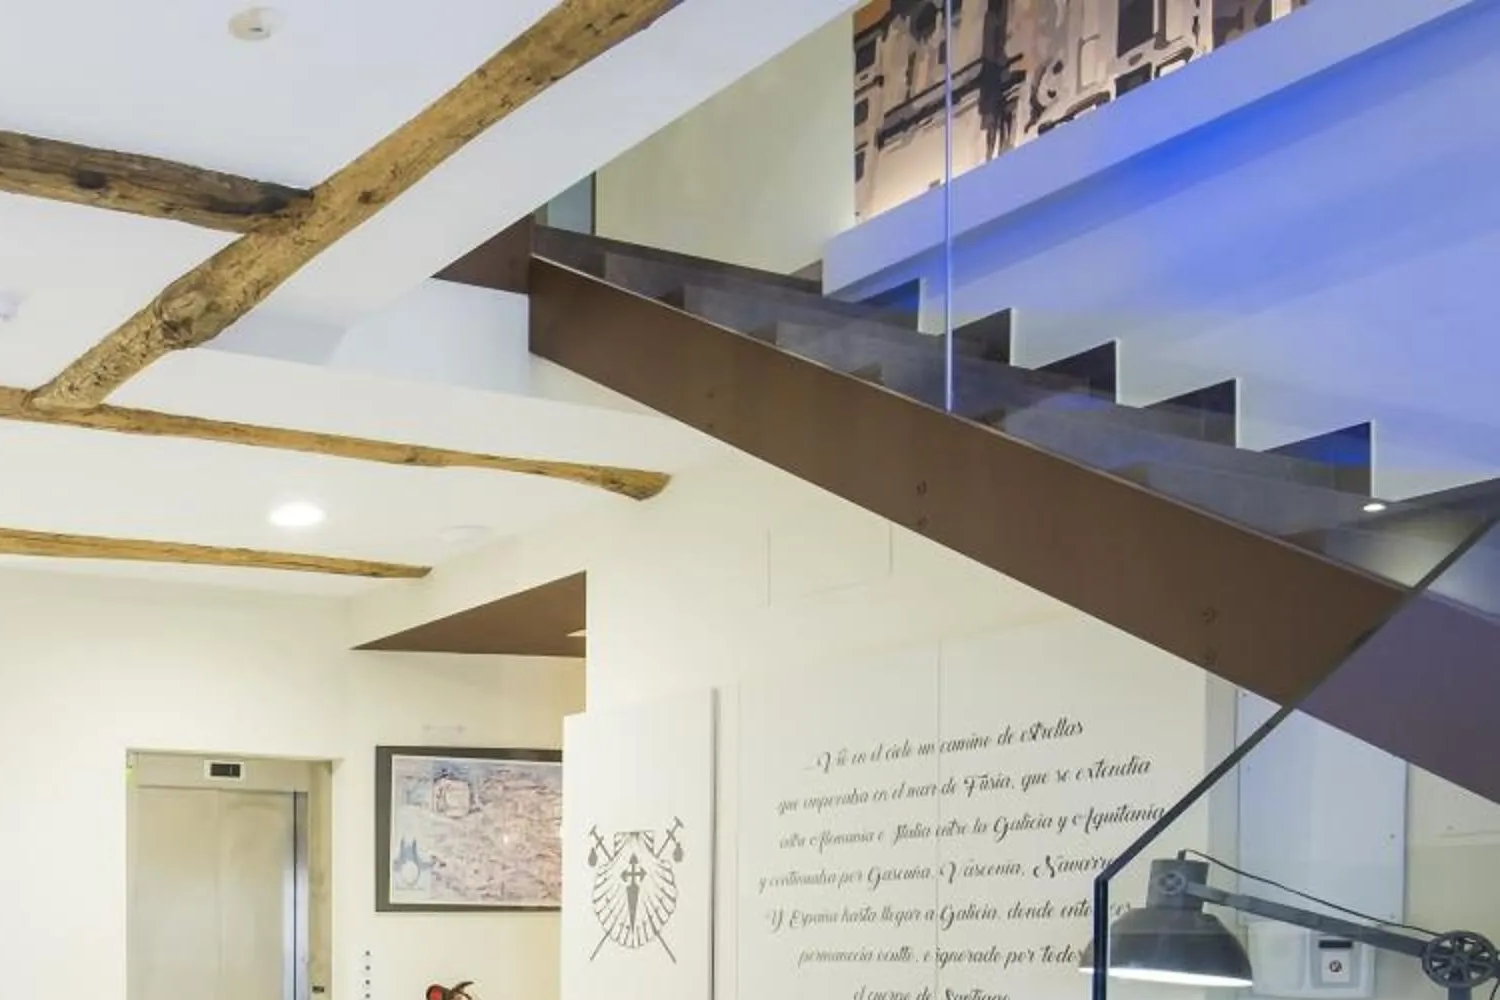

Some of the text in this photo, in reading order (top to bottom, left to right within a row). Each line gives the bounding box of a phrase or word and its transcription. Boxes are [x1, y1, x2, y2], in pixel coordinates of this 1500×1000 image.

[851, 751, 867, 765] en
[871, 744, 883, 762] el
[885, 739, 911, 760] cielo
[917, 743, 935, 756] un
[940, 732, 991, 753] camino
[997, 725, 1013, 745] de
[1020, 716, 1084, 742] estrellas
[776, 800, 798, 816] que
[873, 789, 888, 801] en
[892, 781, 906, 799] el
[906, 783, 937, 797] mar
[941, 776, 956, 794] de
[1021, 773, 1048, 792] que
[1056, 768, 1071, 783] se
[935, 819, 966, 837] entre
[993, 812, 1053, 843] Galicia
[1057, 816, 1069, 835] y
[841, 905, 877, 924] hasta
[881, 905, 920, 928] llegar
[924, 910, 935, 921] a
[1007, 901, 1055, 919] donde
[1004, 950, 1035, 970] por
